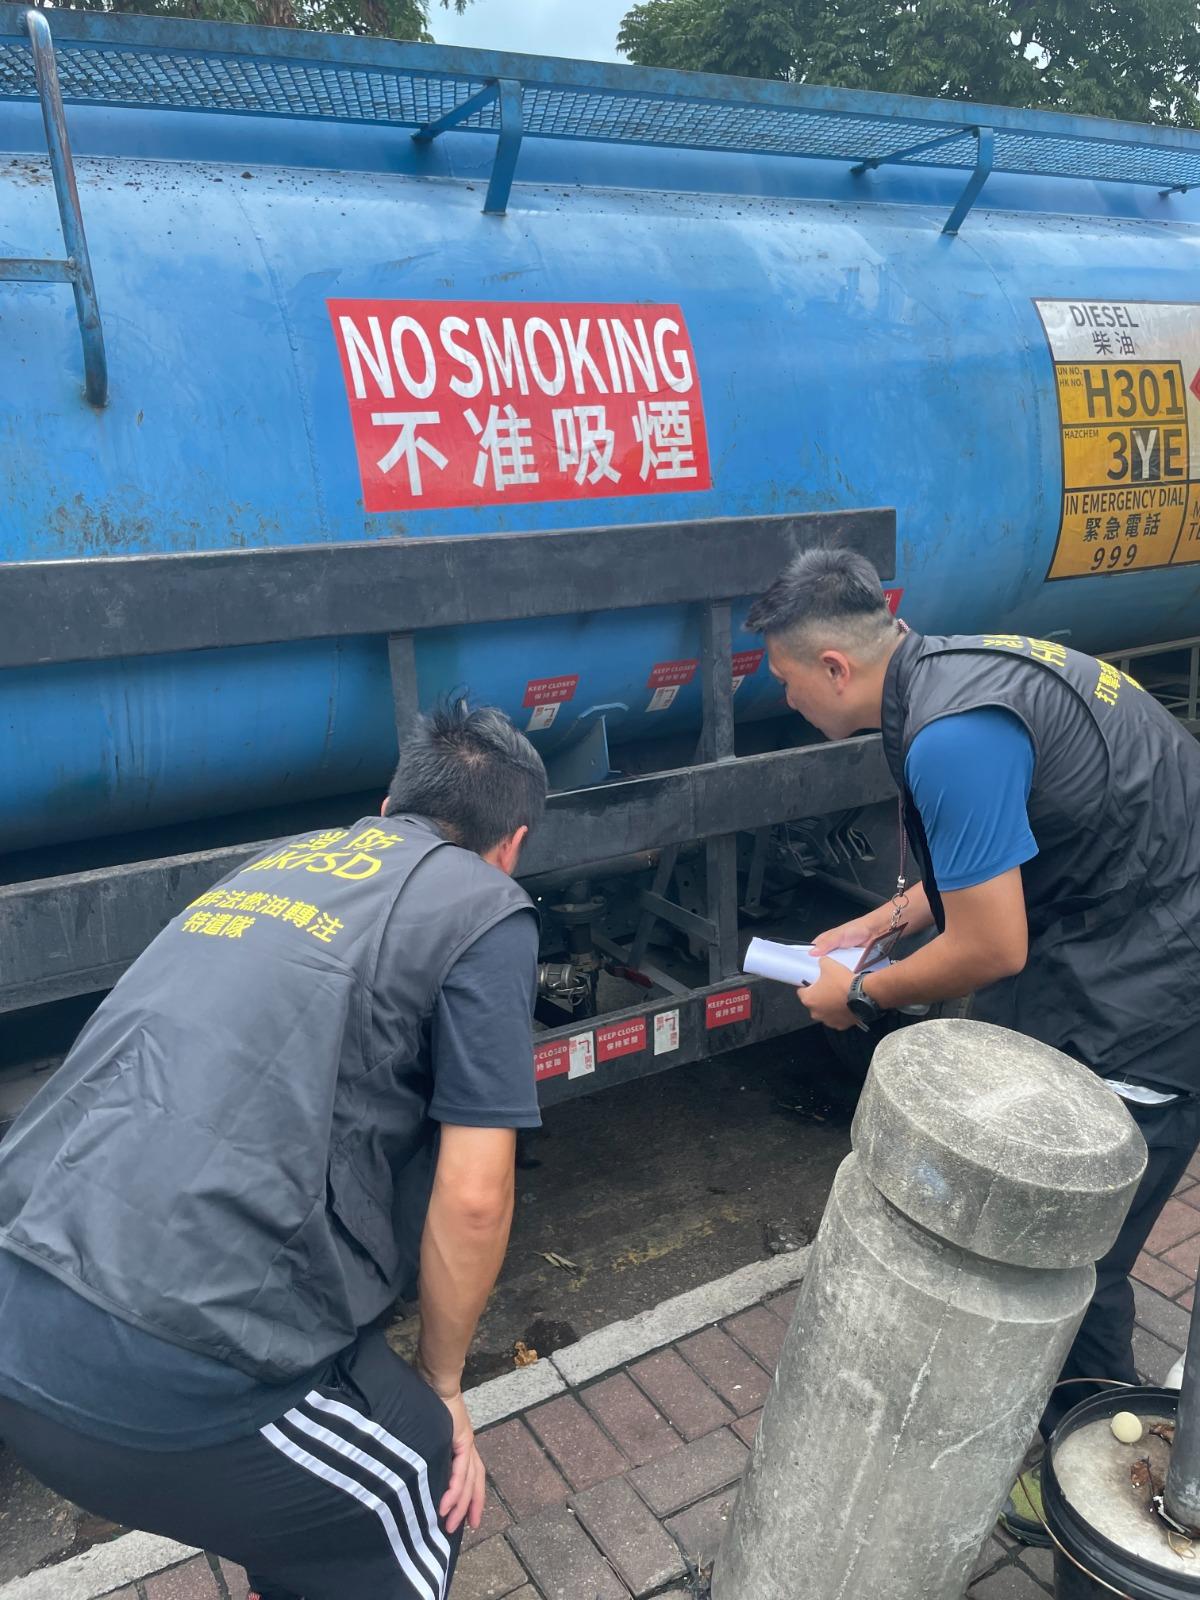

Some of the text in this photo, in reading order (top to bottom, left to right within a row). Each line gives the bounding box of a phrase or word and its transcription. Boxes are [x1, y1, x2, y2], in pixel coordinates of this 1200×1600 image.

[1069, 304, 1139, 328] DIESEL
[1091, 331, 1137, 356] 柴油
[338, 315, 694, 399] NO SMOKING
[1057, 366, 1068, 376] UN
[1083, 369, 1184, 418] H301
[1064, 429, 1099, 439] HAZCHEM
[371, 400, 698, 496] 不准吸煙
[1107, 428, 1183, 481] 3YE
[1065, 488, 1184, 516] IN EMERGENCY DIAL
[1083, 512, 1161, 541] 緊急電話
[1091, 544, 1137, 571] 999
[528, 680, 576, 692] KEEP CLOSED
[707, 994, 750, 1009] KEEP CLOSED
[598, 1031, 617, 1042] KEEP
[617, 1024, 645, 1037] CLOSED
[539, 1046, 568, 1060] CLOSED
